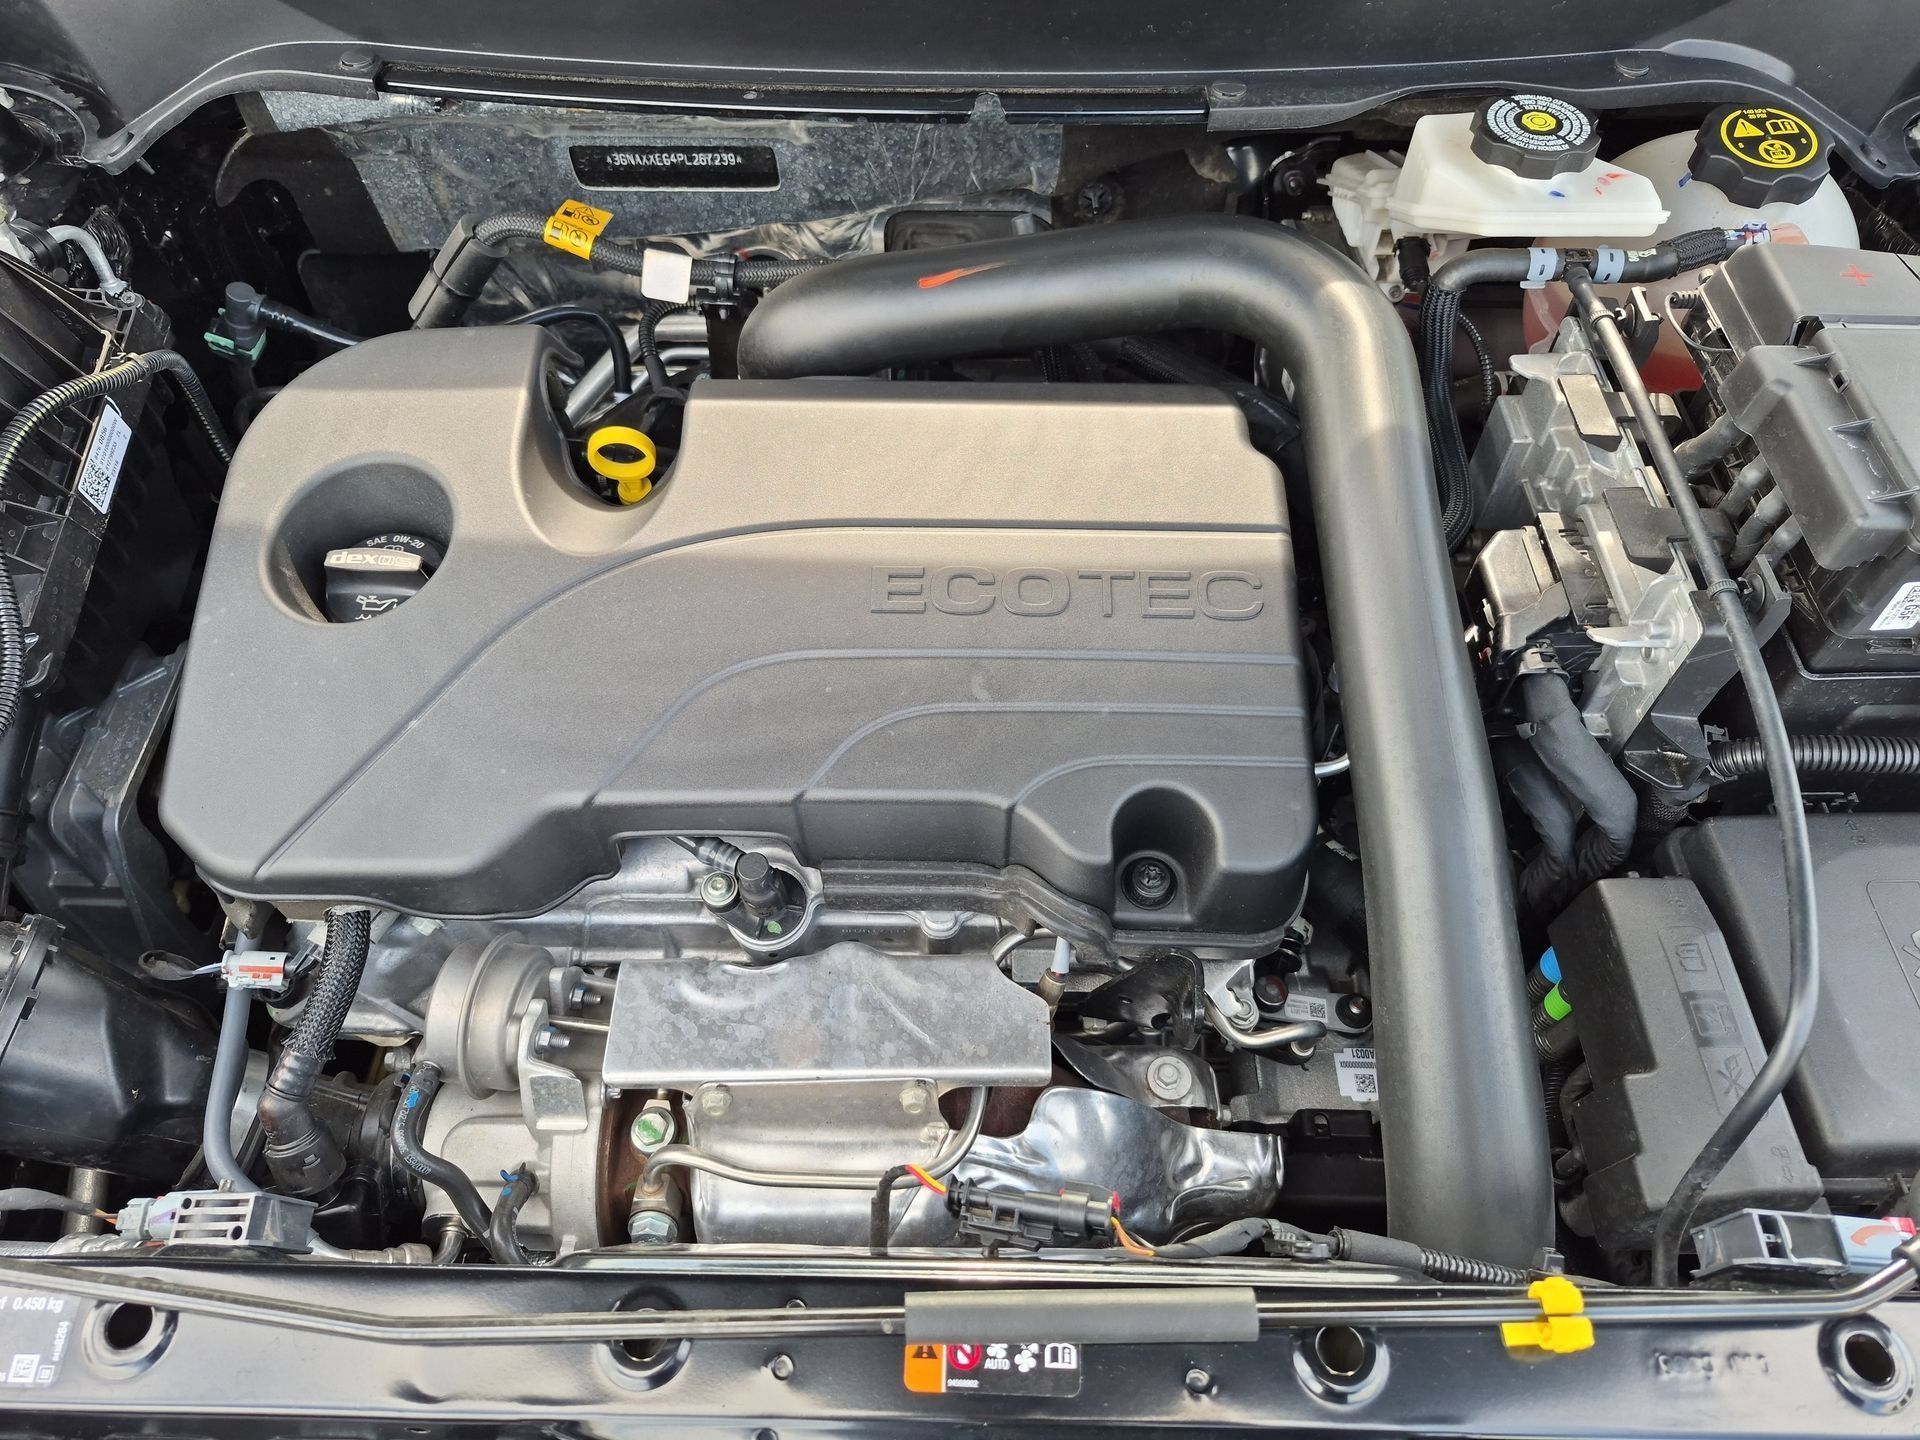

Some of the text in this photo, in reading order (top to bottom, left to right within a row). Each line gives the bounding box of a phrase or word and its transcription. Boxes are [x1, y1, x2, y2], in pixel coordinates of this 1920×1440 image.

[366, 534, 425, 549] SAE 0W-20
[329, 551, 413, 567] dexos
[870, 565, 1265, 622] ECOTEC
[1351, 1048, 1375, 1059] A0031
[12, 1296, 46, 1311] 0.450
[46, 1296, 64, 1313] kg
[984, 1358, 1010, 1370] AUTO
